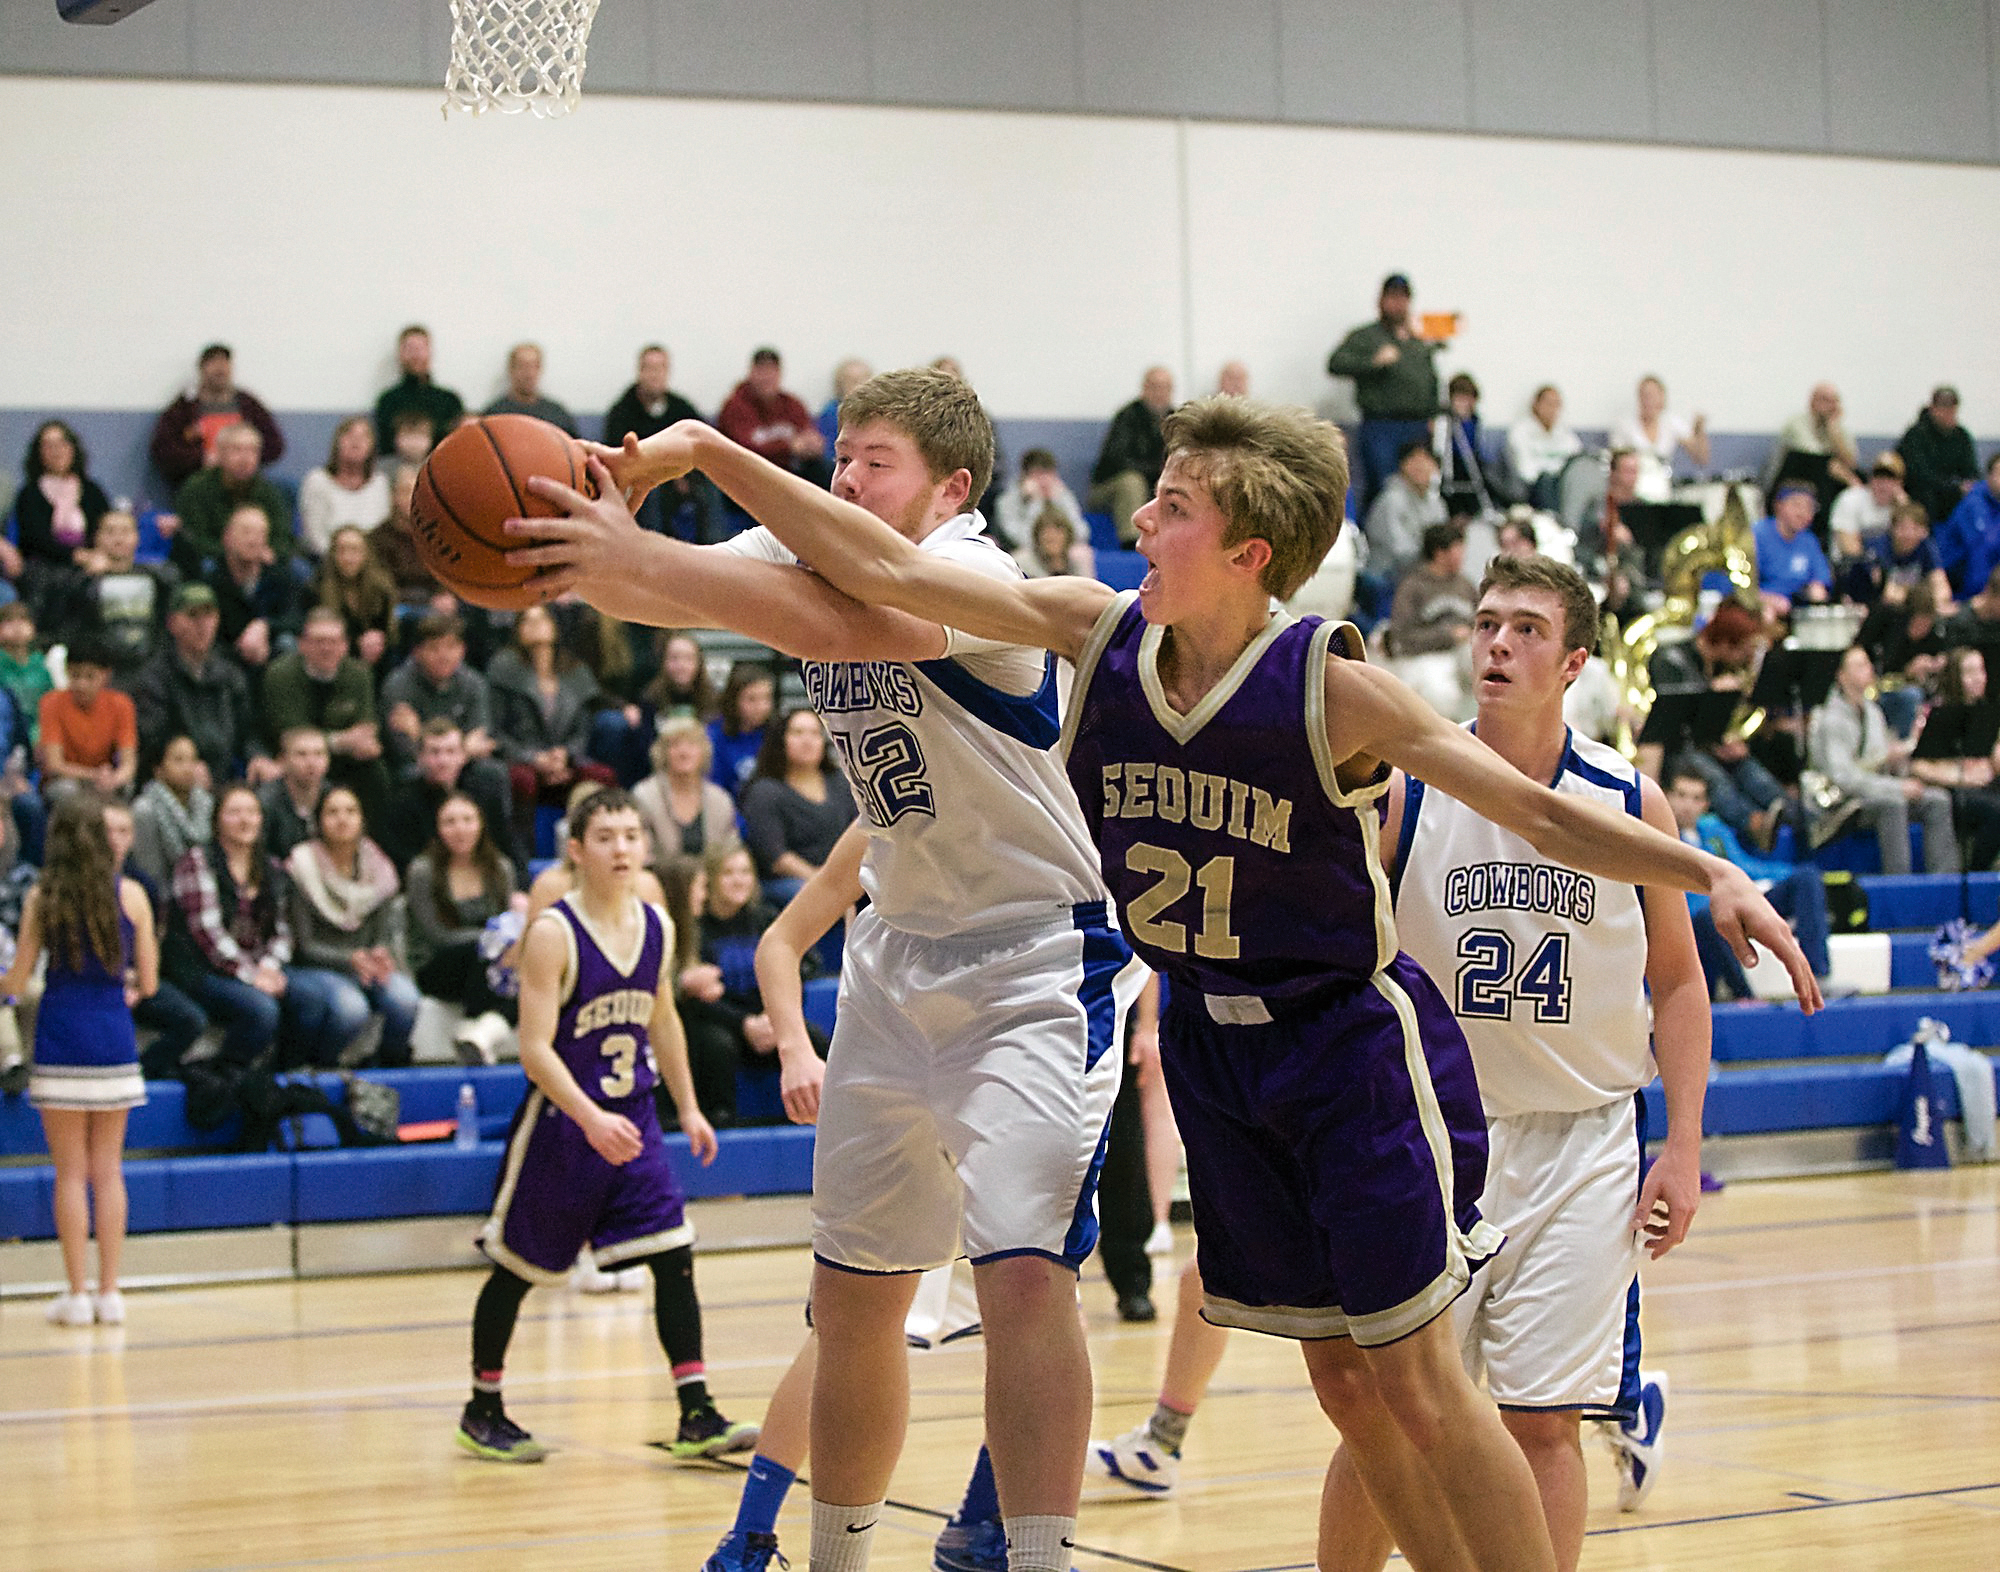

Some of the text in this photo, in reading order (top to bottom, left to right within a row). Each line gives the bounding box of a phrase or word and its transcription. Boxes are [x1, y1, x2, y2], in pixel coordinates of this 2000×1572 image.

[1102, 762, 1293, 854] SEQUIM
[1125, 841, 1240, 959] 21
[1444, 861, 1596, 926] COWBOYS
[573, 988, 656, 1039] SEQU
[1455, 927, 1572, 1024] 24
[600, 1033, 637, 1098] 3
